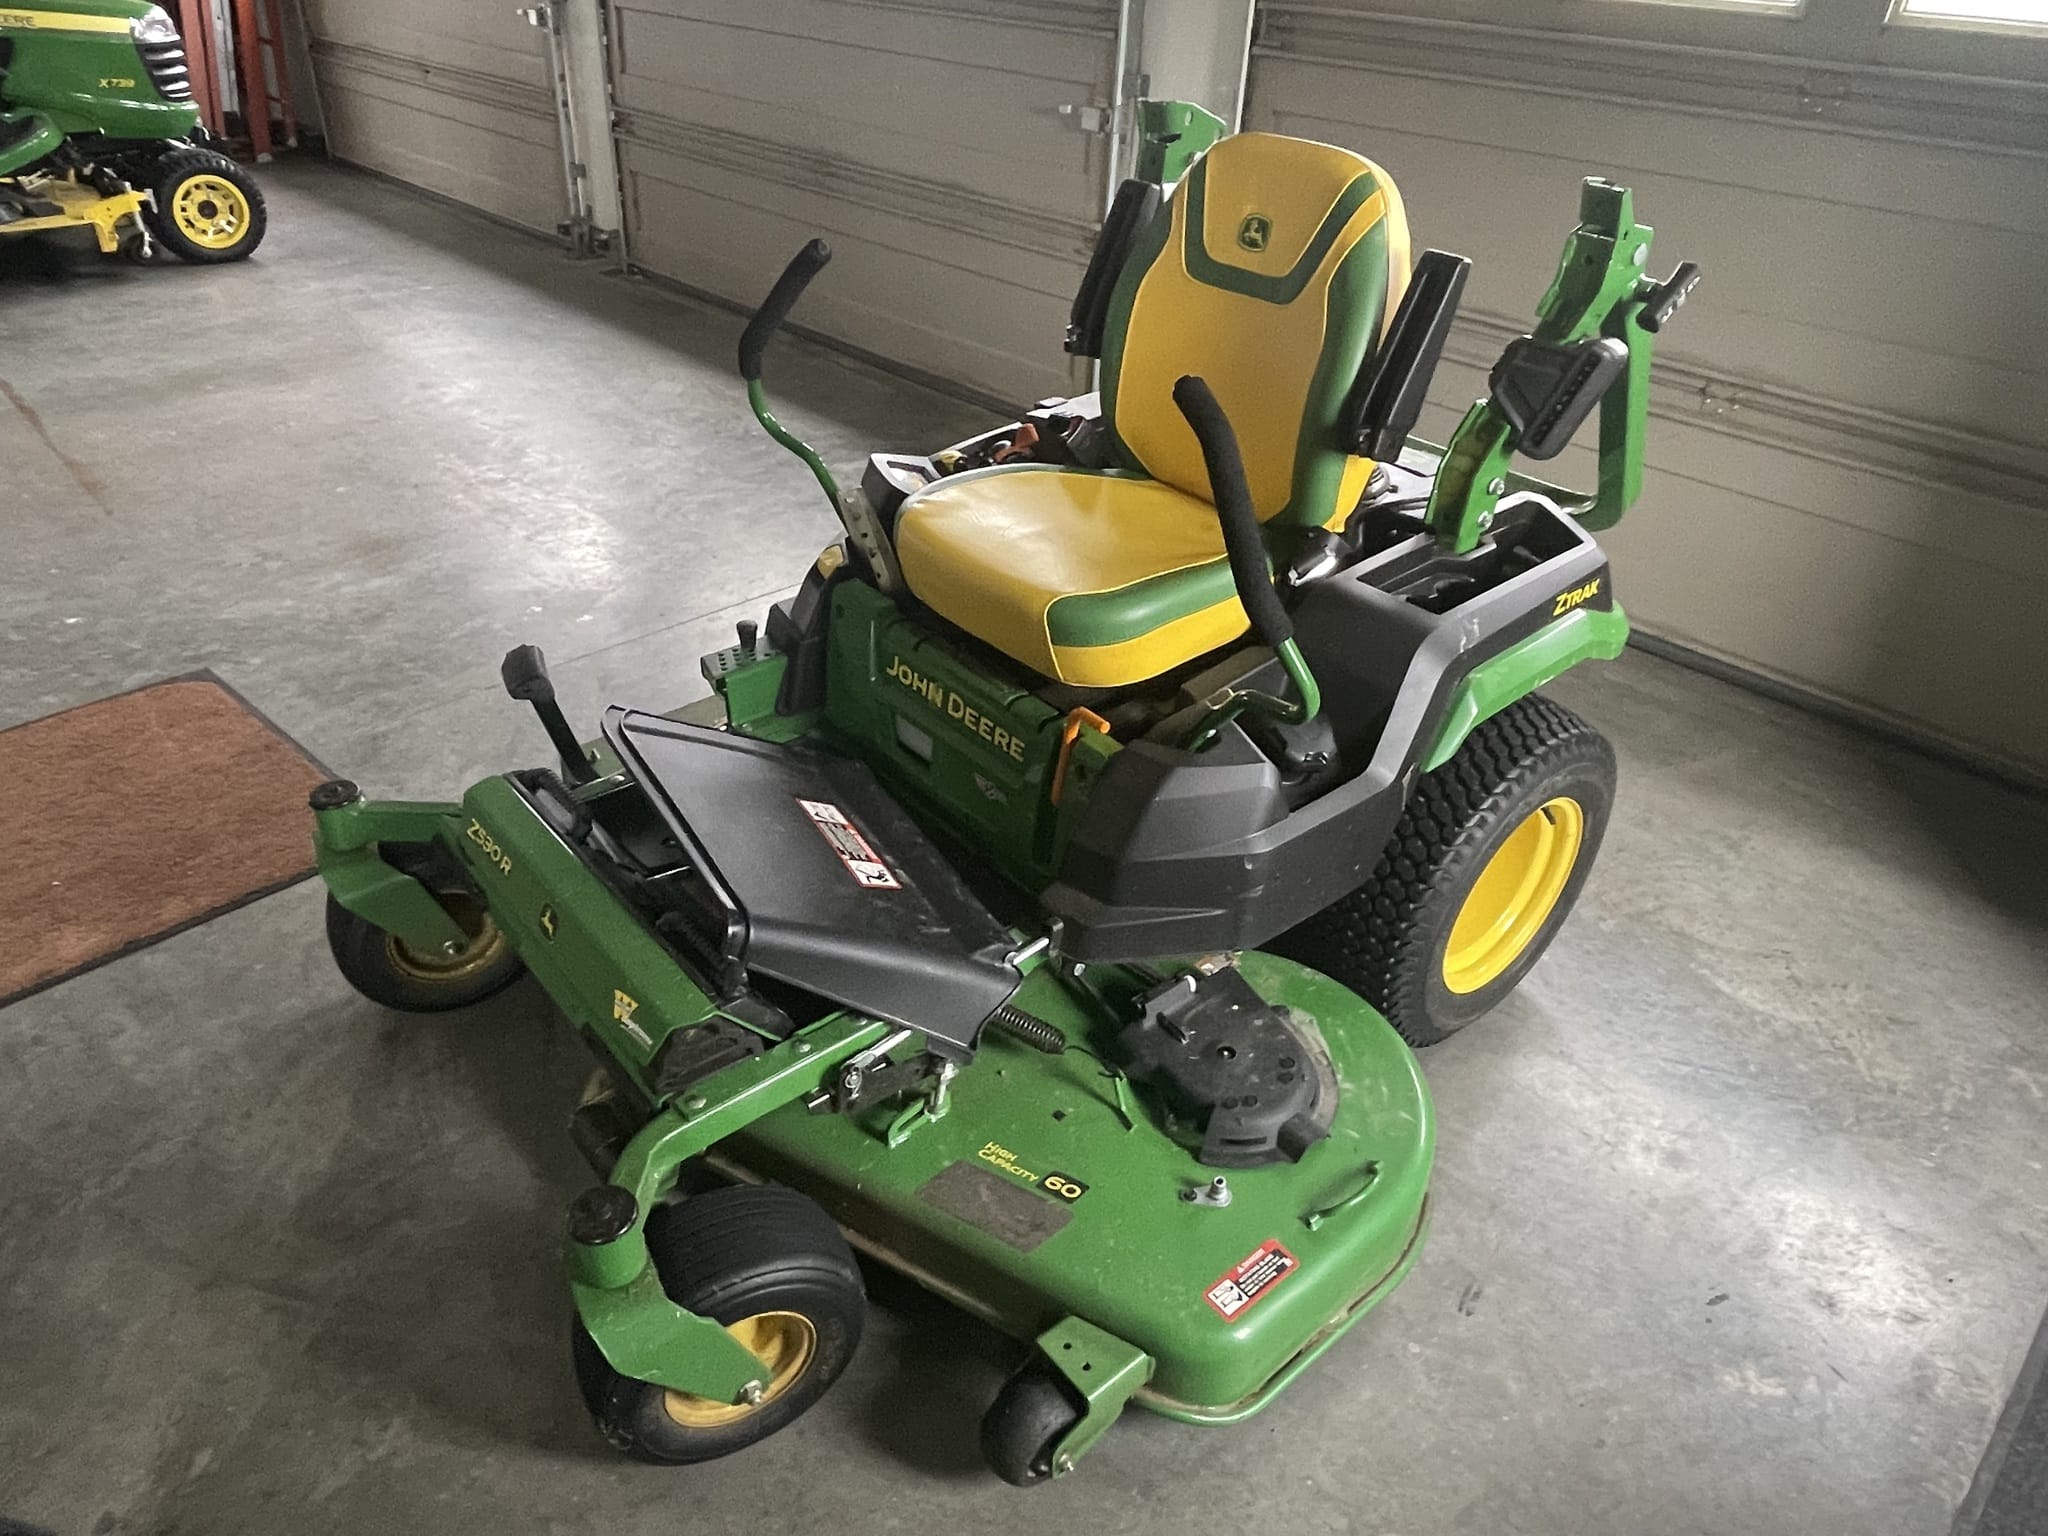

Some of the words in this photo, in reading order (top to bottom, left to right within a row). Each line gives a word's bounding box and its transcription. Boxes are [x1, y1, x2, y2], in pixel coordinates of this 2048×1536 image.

[0, 13, 36, 27] ERE
[1553, 578, 1600, 616] ZTRAK
[886, 656, 943, 708] JOHN
[948, 692, 1026, 763] DEERE
[1044, 1176, 1082, 1198] 60
